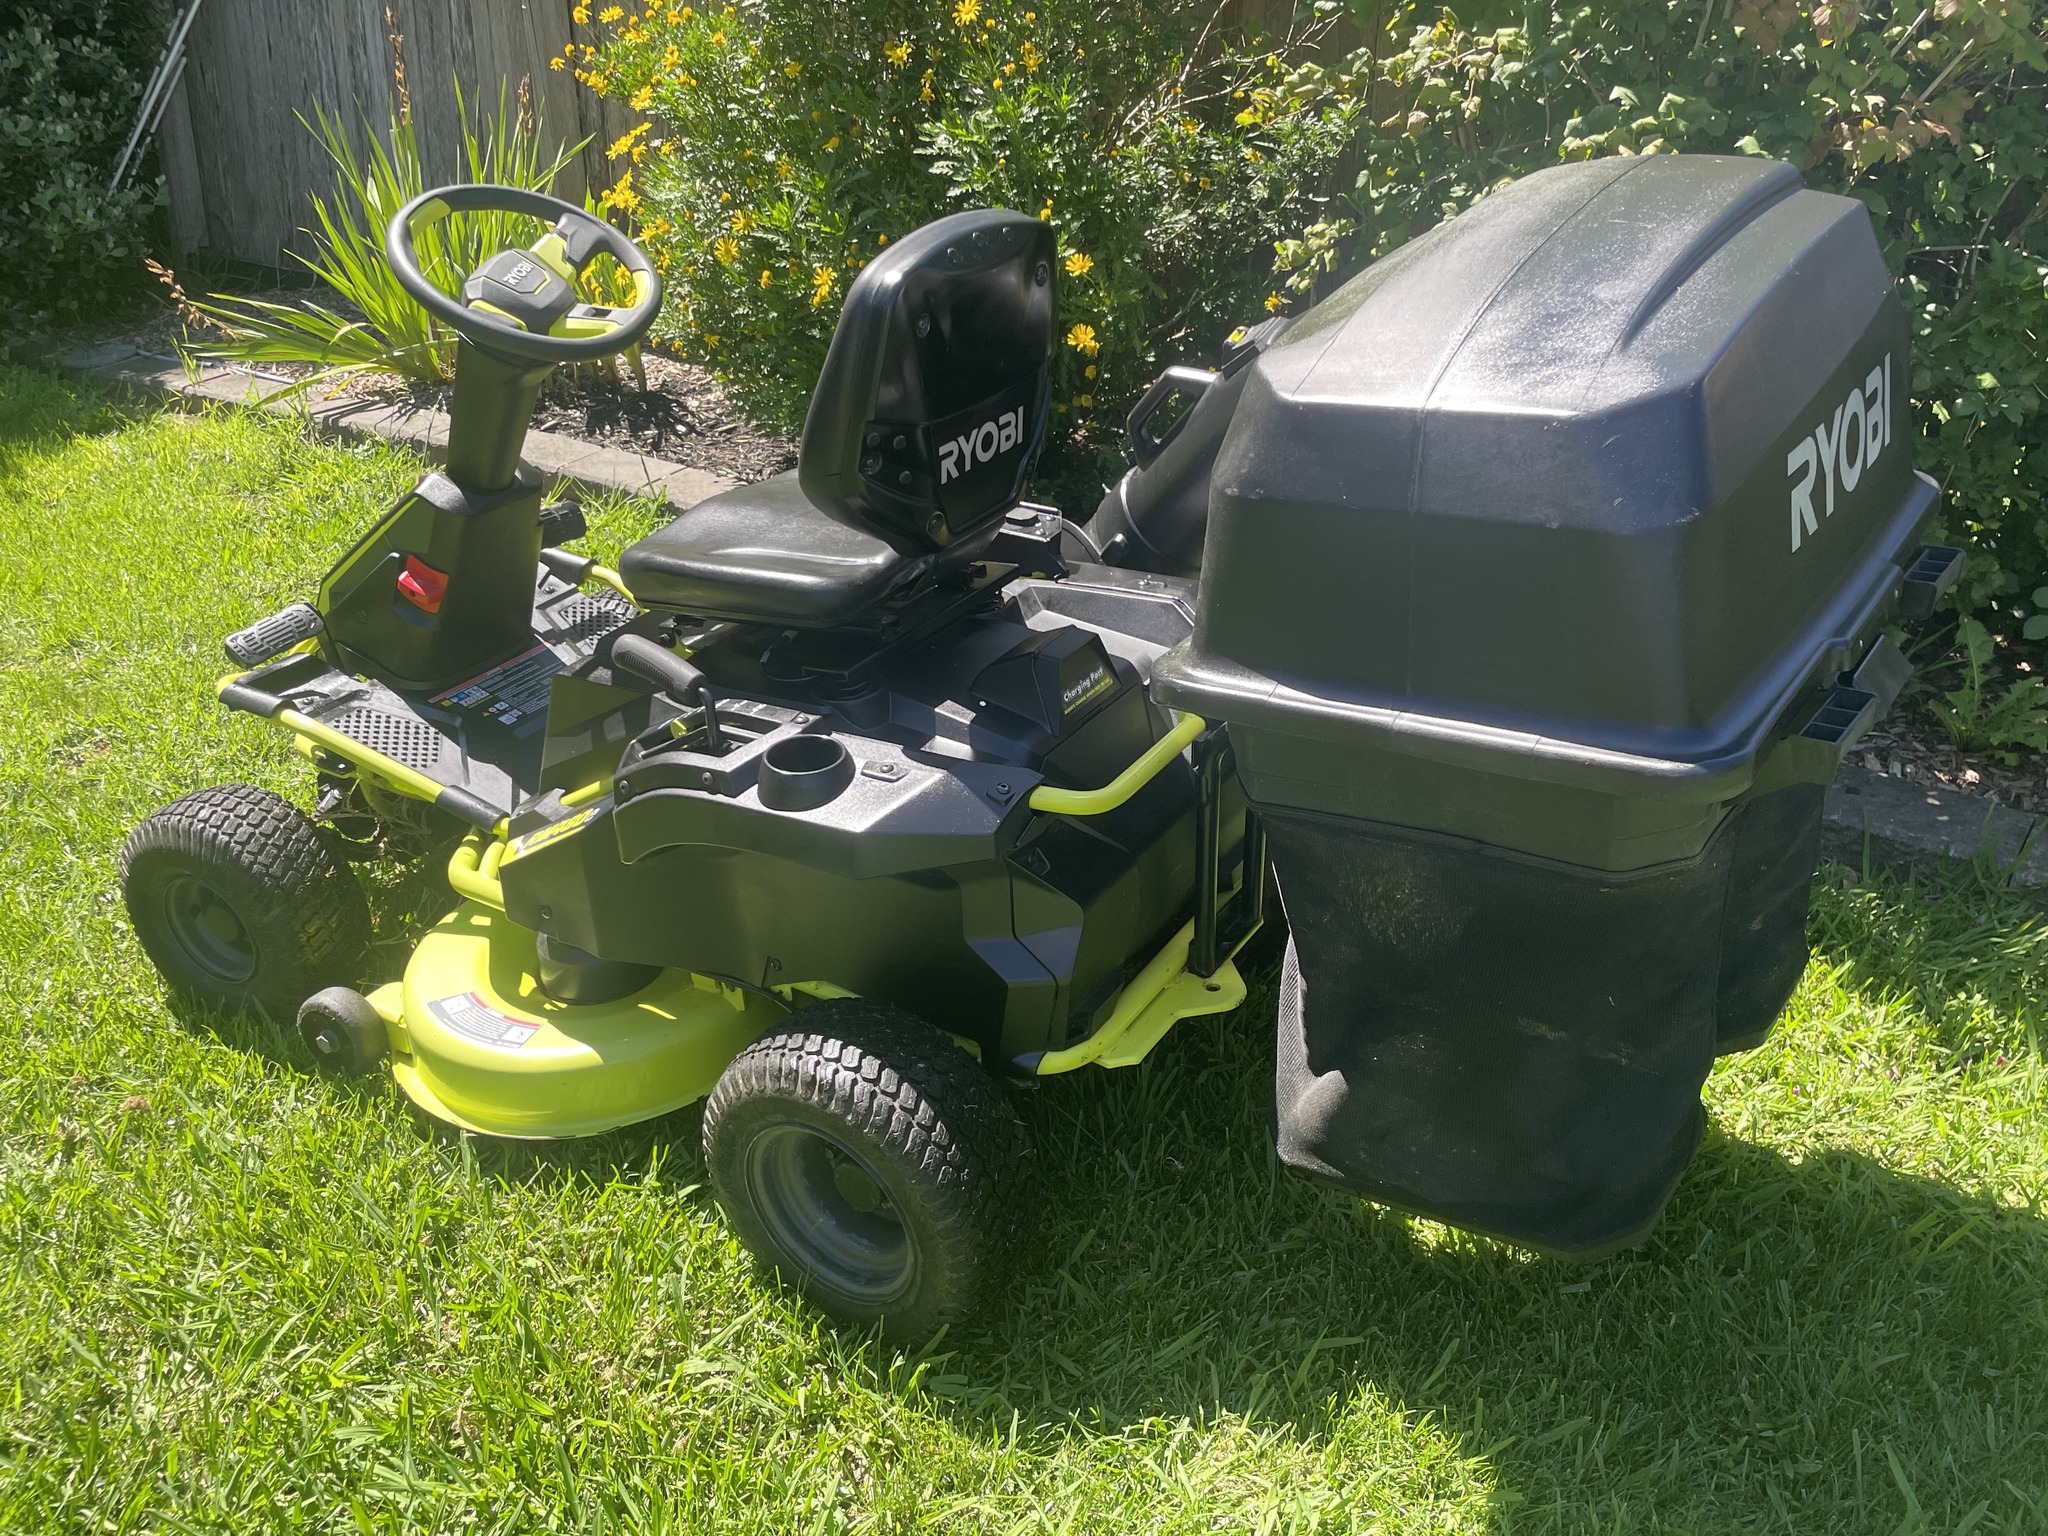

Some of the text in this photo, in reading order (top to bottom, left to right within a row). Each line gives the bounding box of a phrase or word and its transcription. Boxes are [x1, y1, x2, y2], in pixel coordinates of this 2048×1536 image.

[503, 261, 535, 286] RYOBI
[938, 405, 1024, 485] RYOBI
[1788, 352, 1891, 554] RYOBI
[1063, 668, 1103, 701] Charging Port
